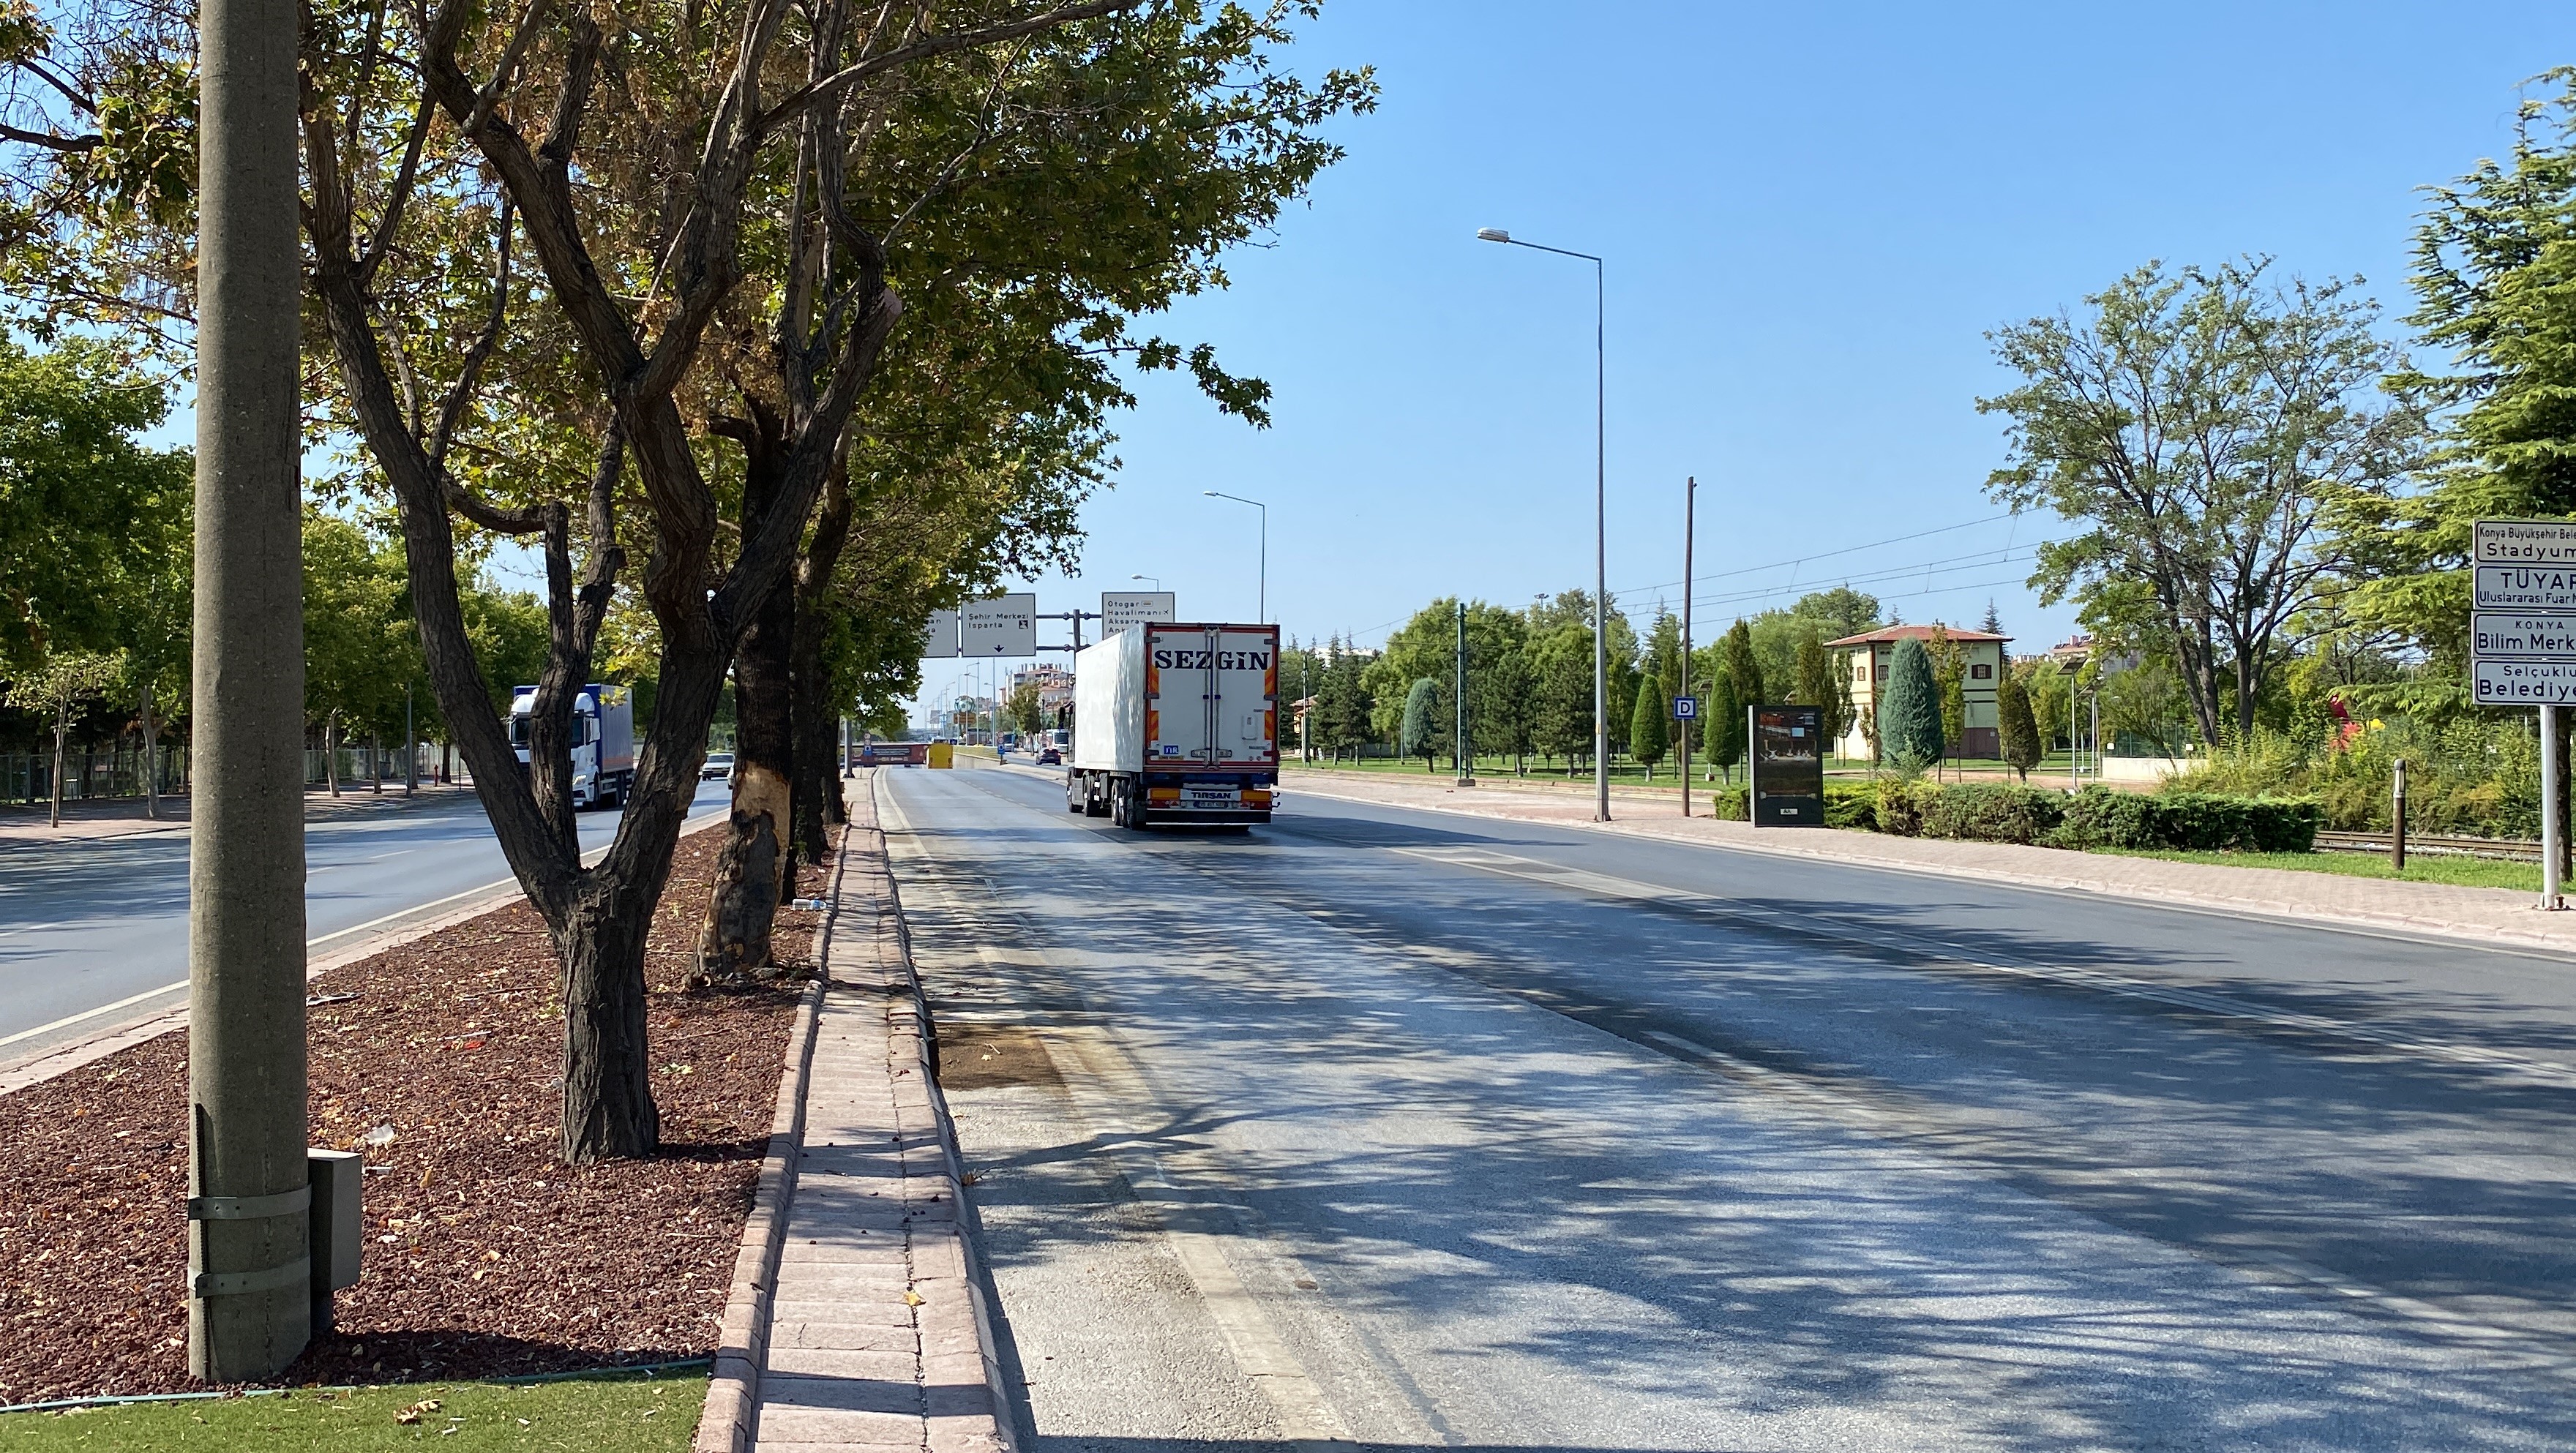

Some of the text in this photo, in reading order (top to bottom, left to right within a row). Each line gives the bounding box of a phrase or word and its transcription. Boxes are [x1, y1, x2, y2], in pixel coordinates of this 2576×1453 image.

[2479, 527, 2506, 541] Konya
[2509, 527, 2557, 541] Büyükşehir
[2479, 591, 2543, 604] Uluslararası
[2546, 593, 2570, 604] Fuar
[2515, 620, 2564, 629] KONYA
[2478, 633, 2576, 650] Bilim Merk
[2504, 665, 2576, 678] Selçuklu
[1681, 702, 1690, 713] D
